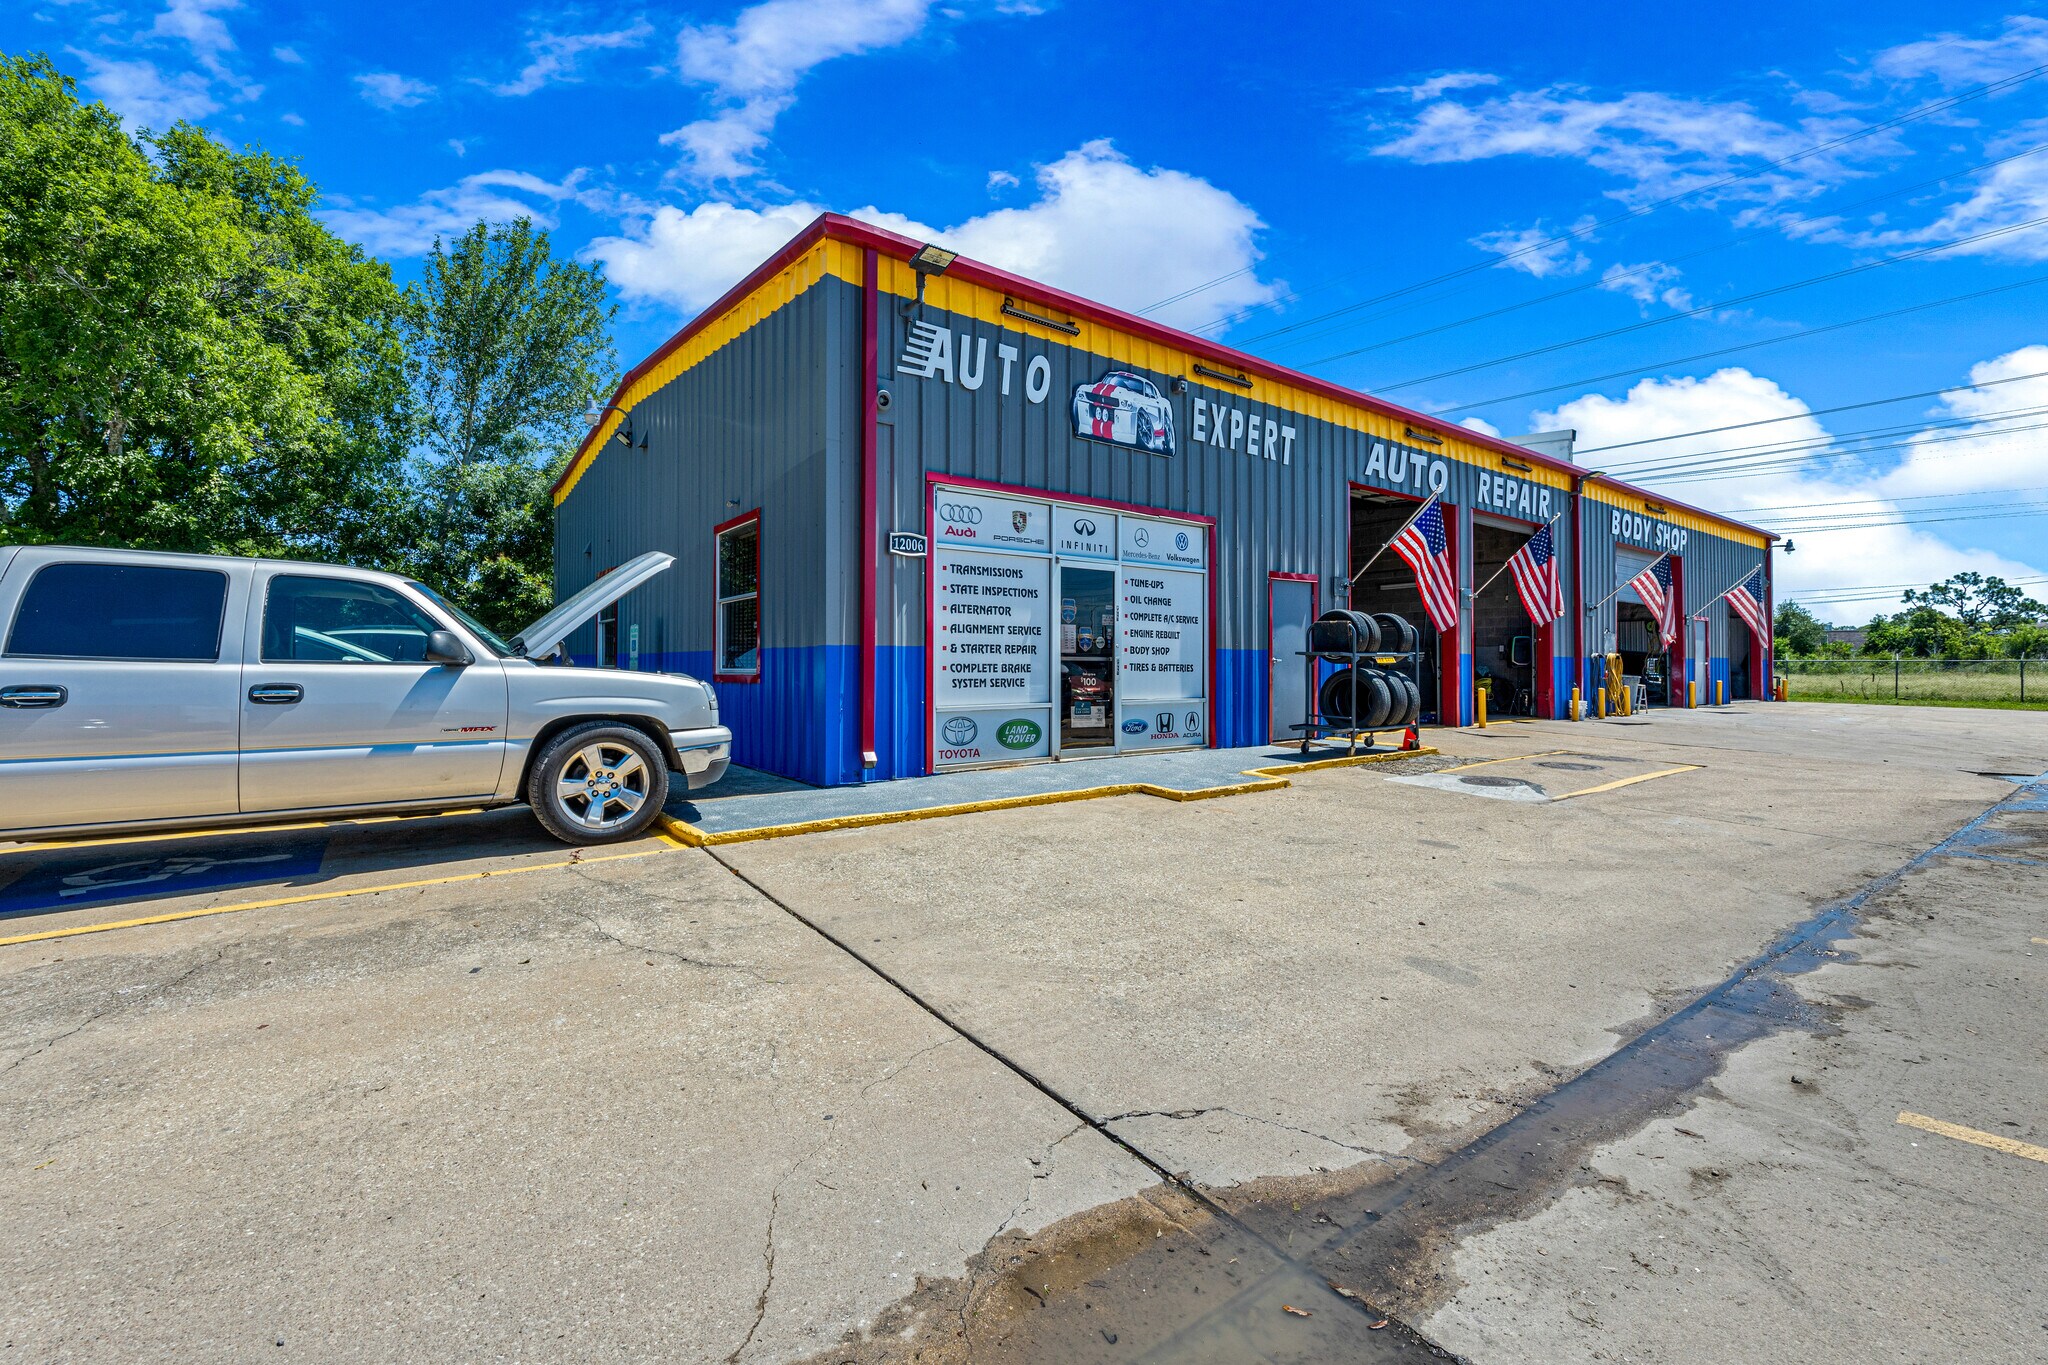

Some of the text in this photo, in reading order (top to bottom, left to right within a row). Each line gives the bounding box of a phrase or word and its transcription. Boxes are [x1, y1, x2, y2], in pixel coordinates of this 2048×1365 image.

[897, 320, 1296, 465] AUTO EXPERT
[1365, 442, 1550, 519] AUTO REPAIR
[945, 525, 976, 538] Audi
[1611, 510, 1687, 551] BODY SHOP
[893, 537, 924, 552] 12006
[993, 534, 1045, 546] PORSCHE
[1061, 540, 1108, 553] INFINITI
[1123, 550, 1160, 560] Mercedes-Benz
[1166, 553, 1200, 564] Volkswagen
[950, 564, 1024, 579] TRANSMISSIONS
[1130, 578, 1164, 590] TUNE-UPS
[950, 584, 1039, 598] STATE INSPECTIONS
[1130, 595, 1172, 606] OIL CHANGE
[950, 604, 1012, 617] ALTERNATOR
[1130, 612, 1162, 623] COMPLETE
[1163, 614, 1175, 625] A/C
[1175, 615, 1199, 625] SERVICE
[950, 624, 1042, 636] ALIGNMENT SERVICE
[1130, 629, 1181, 640] ENGINE REBUILT
[950, 643, 1037, 655] & STARTER REPAIR
[1130, 646, 1170, 656] BODY SHOP
[950, 663, 1031, 673] COMPLETE BRAKE
[1129, 663, 1150, 673] TIRES
[1151, 663, 1157, 672] &
[1158, 663, 1194, 673] BATTERIES
[952, 678, 1025, 689] SYSTEM SERVICE
[1125, 723, 1144, 732] Ford
[1150, 732, 1180, 740] HONDA
[938, 749, 981, 760] TOYOTA
